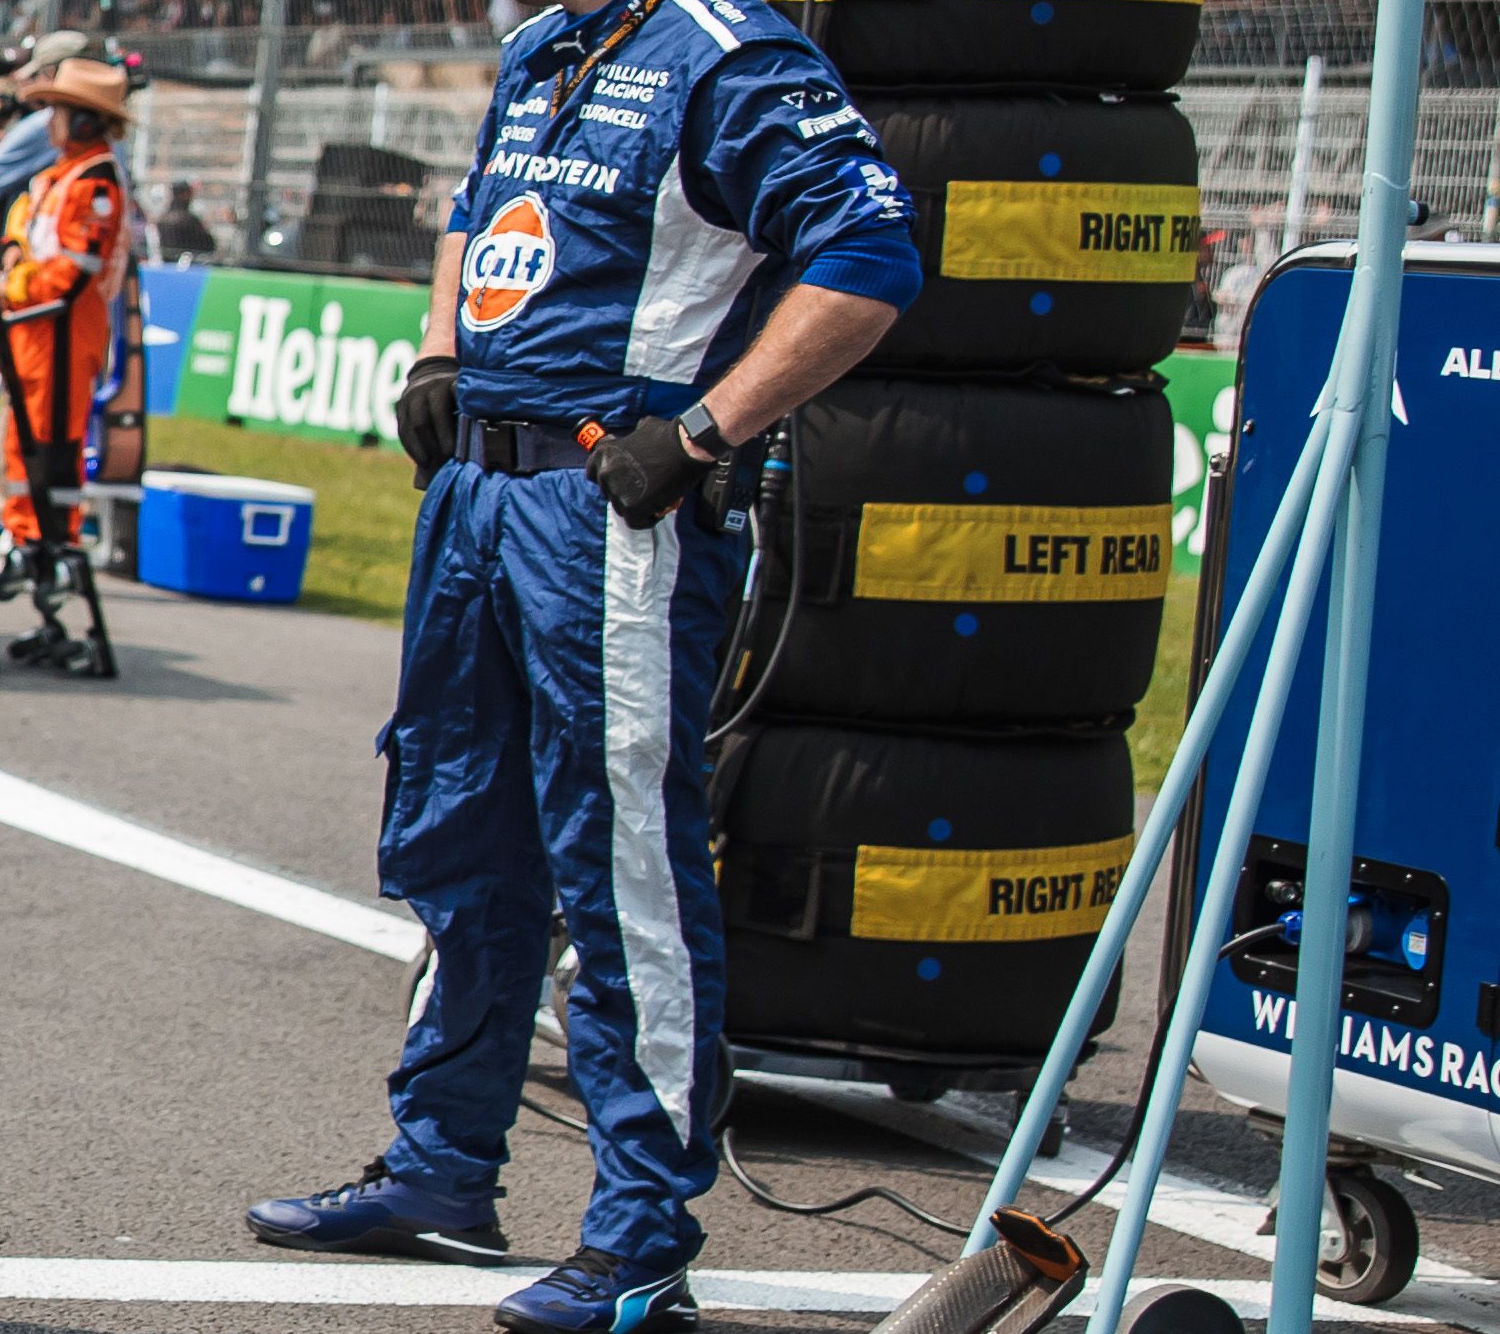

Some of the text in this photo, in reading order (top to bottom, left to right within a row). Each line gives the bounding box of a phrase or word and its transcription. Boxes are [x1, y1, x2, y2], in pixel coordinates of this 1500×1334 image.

[593, 78, 655, 103] RACING
[596, 62, 670, 87] WILLIAMS
[579, 103, 648, 130] DURACELL
[1079, 212, 1165, 252] RIGHT
[227, 294, 430, 441] Heine
[1003, 533, 1162, 577] LEFT REAR
[988, 871, 1086, 916] RIGHT
[1252, 989, 1435, 1078] WIIAMS
